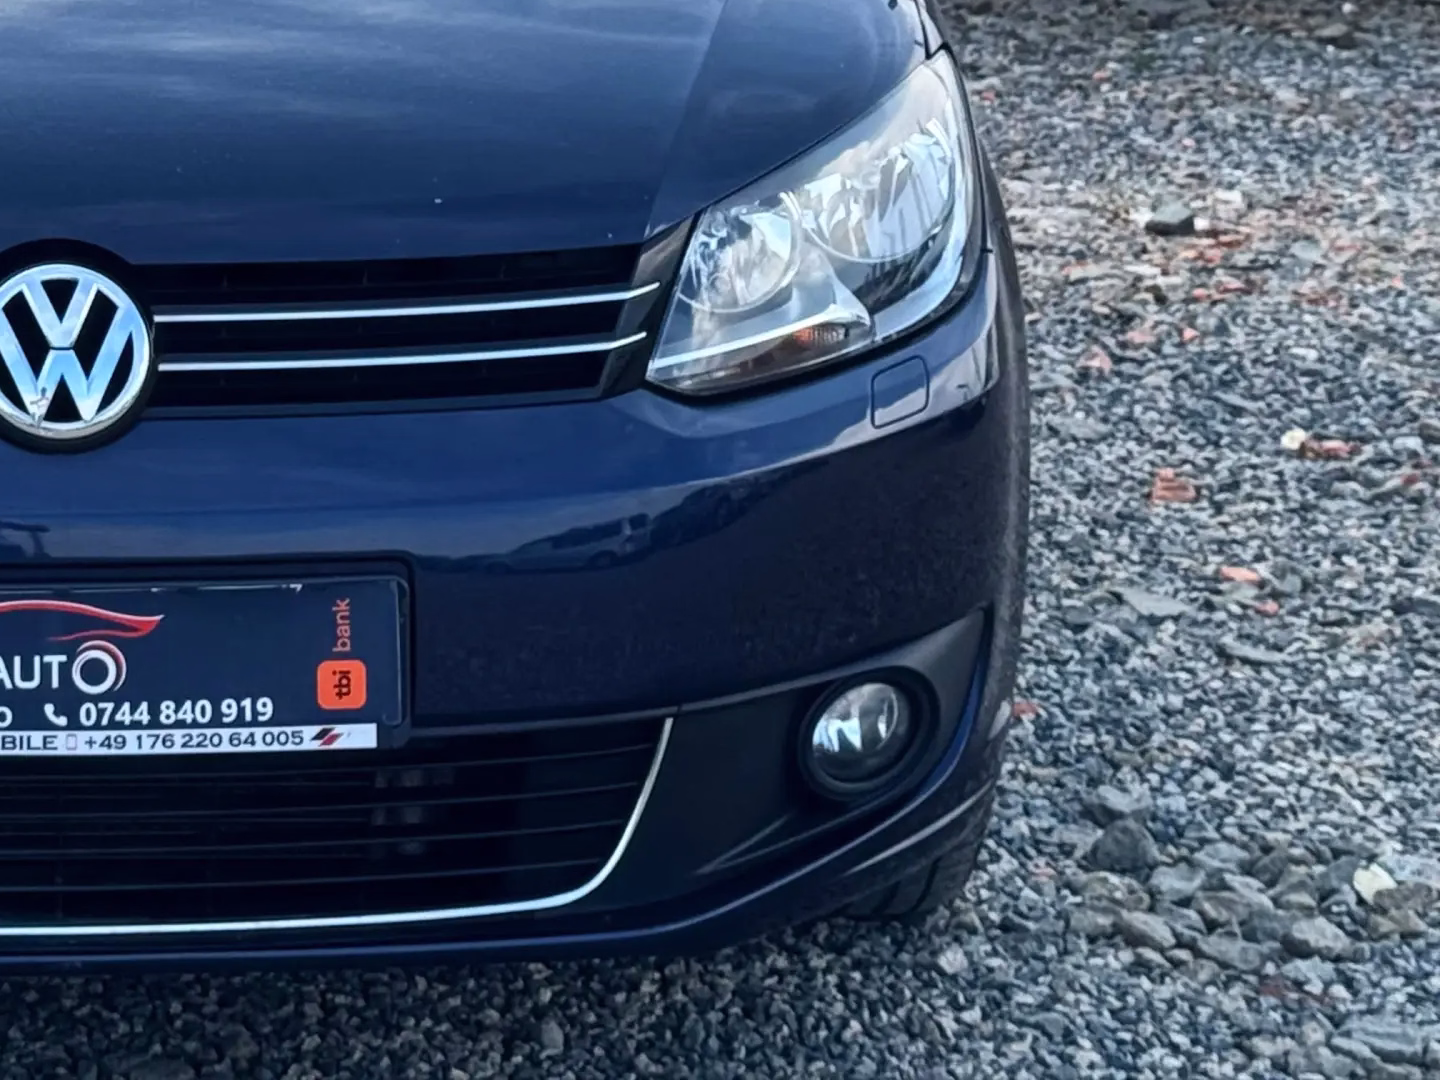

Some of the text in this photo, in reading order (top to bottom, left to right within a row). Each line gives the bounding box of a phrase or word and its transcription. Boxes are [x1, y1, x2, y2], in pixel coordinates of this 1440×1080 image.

[332, 597, 351, 701] tbi bank
[79, 697, 274, 727] 0744 840 919
[84, 734, 127, 750] +49
[136, 734, 175, 750] 176
[180, 732, 223, 749] 220
[228, 731, 257, 747] 64
[262, 730, 304, 747] 005
